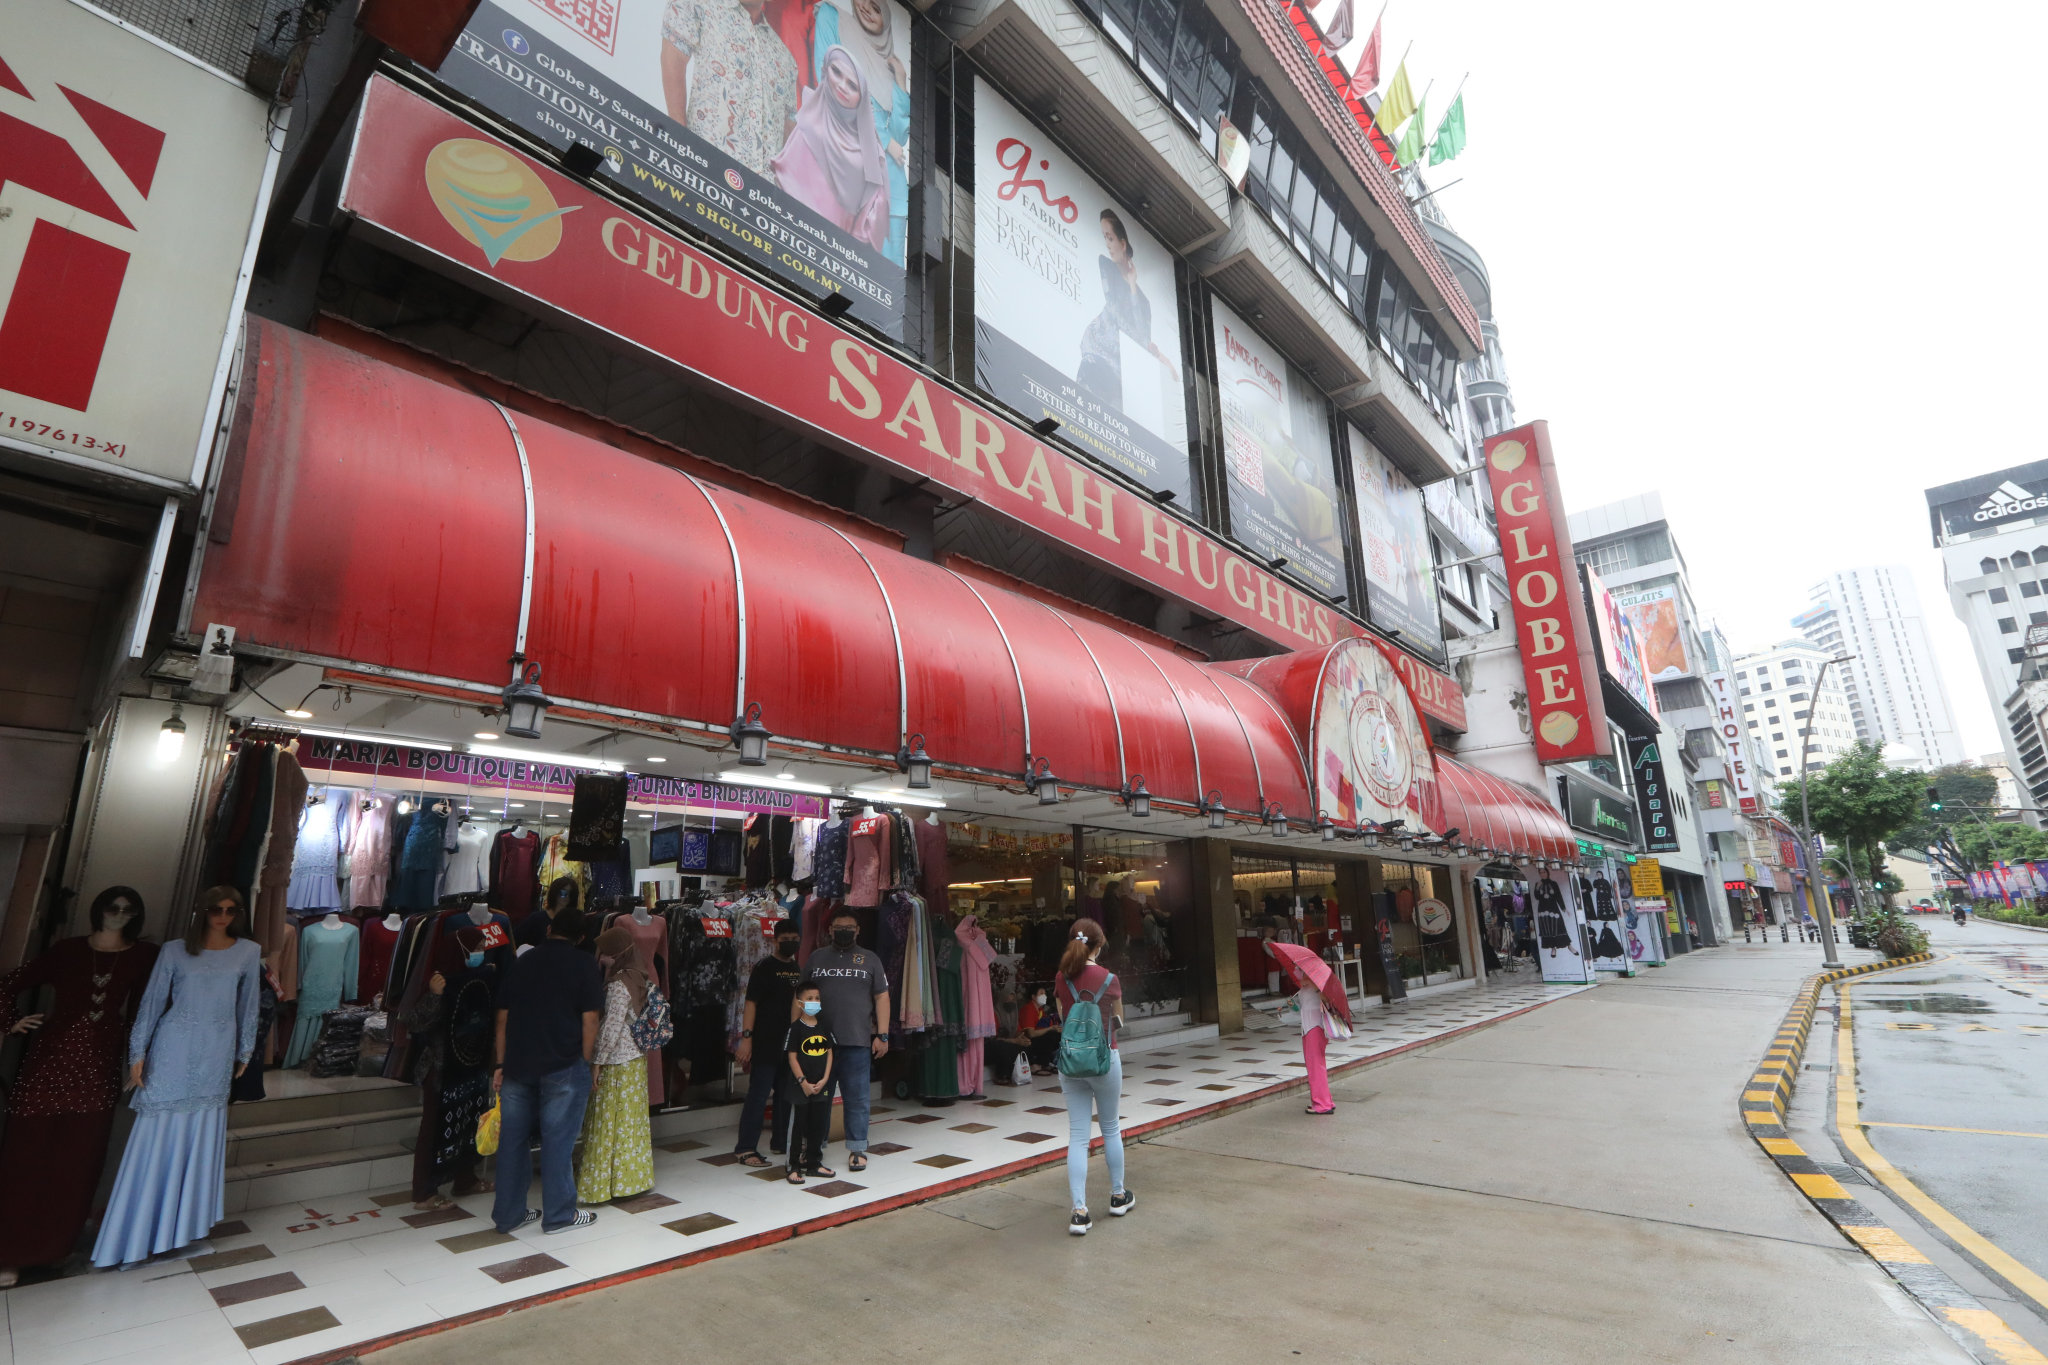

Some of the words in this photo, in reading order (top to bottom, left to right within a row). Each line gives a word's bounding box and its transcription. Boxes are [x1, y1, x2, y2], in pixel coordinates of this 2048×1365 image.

[535, 52, 586, 91] Globe
[588, 83, 610, 106] By
[611, 100, 654, 134] Sarah
[656, 127, 709, 169] Hughes
[455, 32, 622, 143] TRADITIONAL
[647, 147, 735, 211] FASHION
[755, 215, 817, 261] OFFICE
[819, 255, 893, 306] APPARELS
[535, 110, 578, 141] shop
[580, 136, 597, 151] at
[695, 202, 773, 255] SHGLOBE
[996, 138, 1079, 224] gio
[748, 188, 869, 269] globe_x_sarah_hughes
[996, 206, 1081, 285] DESIGNERS
[1021, 193, 1079, 249] FABRICS
[996, 224, 1082, 304] PARADISE
[600, 215, 811, 353] GEDUNG
[828, 337, 1122, 544] SARAH
[1138, 502, 1334, 648] HUGHES
[1028, 381, 1076, 419] TEXTILES
[1078, 413, 1086, 425] &
[1087, 419, 1118, 445] READY
[1119, 437, 1132, 452] TO
[1131, 445, 1157, 470] WEAR
[1042, 407, 1148, 477] WWW.GIOFABRICS.COM.MY
[1061, 385, 1076, 397] 2nd
[1076, 396, 1084, 407] &
[1087, 402, 1101, 413] 3rd
[1104, 412, 1130, 436] FLOOR
[1246, 519, 1276, 545] CURTAINS
[1281, 541, 1301, 560] BLINDS
[1974, 496, 2048, 522] adidas
[1500, 479, 1576, 706] GLOBE
[1621, 590, 1664, 607] GULATI'S
[311, 739, 400, 767] MARIA
[406, 749, 527, 783] BOUTIQUE
[700, 784, 794, 809] BRIDESMAID
[1713, 678, 1749, 792] T-HOTEL
[1634, 743, 1667, 838] Alfaro
[811, 967, 868, 980] HACKETT
